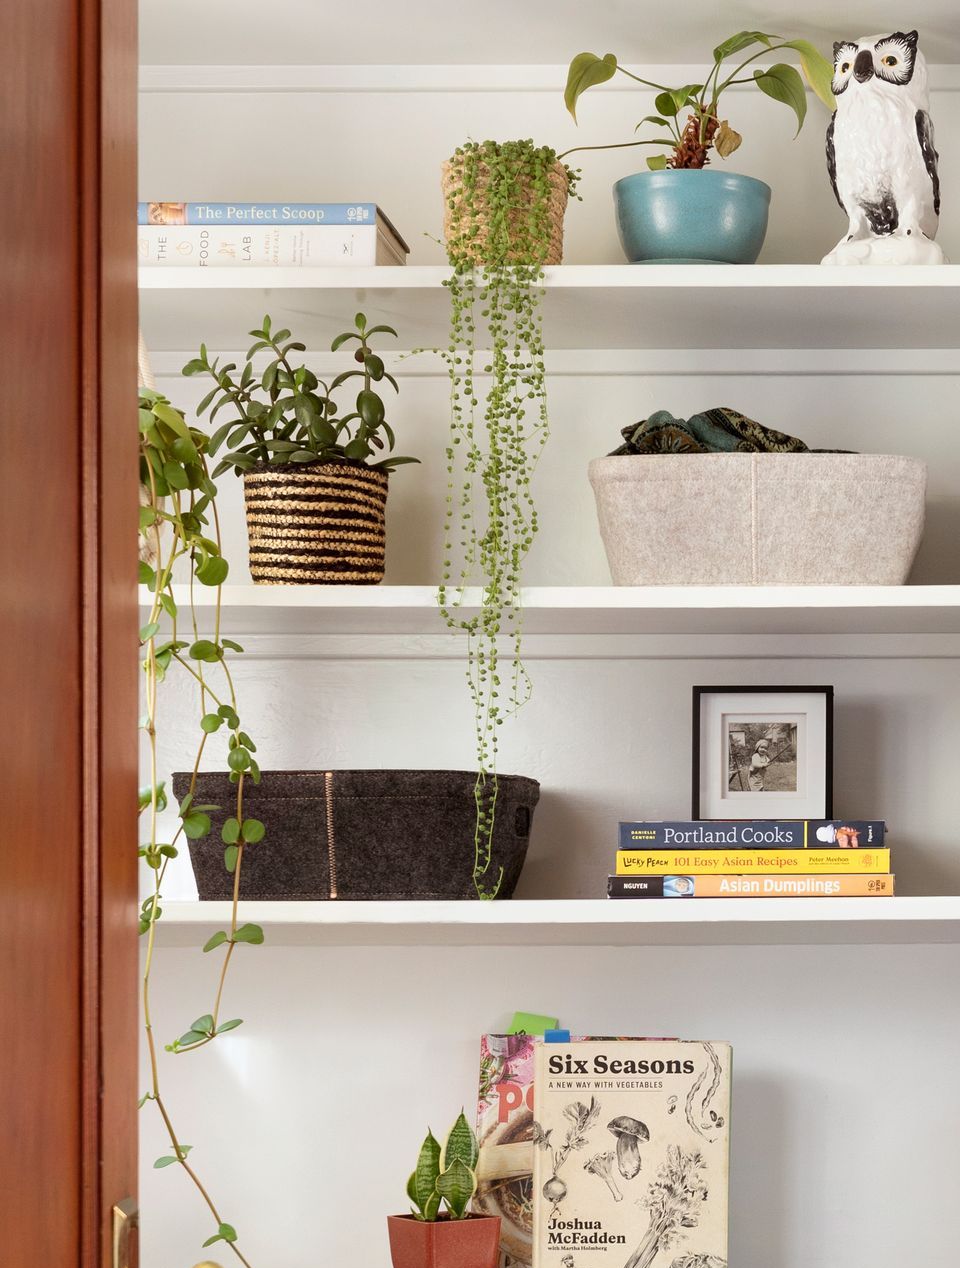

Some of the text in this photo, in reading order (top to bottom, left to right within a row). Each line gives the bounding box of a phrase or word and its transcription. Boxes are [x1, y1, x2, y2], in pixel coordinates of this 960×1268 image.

[195, 206, 325, 222] The Perfect Scoop
[158, 230, 252, 267] THE FOOD LAB
[664, 826, 794, 844] Portland Cooks
[646, 857, 669, 868] PEACH
[674, 856, 798, 869] 101 Easy Asian Recipes
[719, 878, 840, 894] Asian Dumplings
[548, 1054, 695, 1074] Six Seasons
[548, 1081, 664, 1089] A NEW WAY WITH VEGETABLES
[548, 1218, 602, 1230] Joshua
[548, 1232, 626, 1244] McFadden
